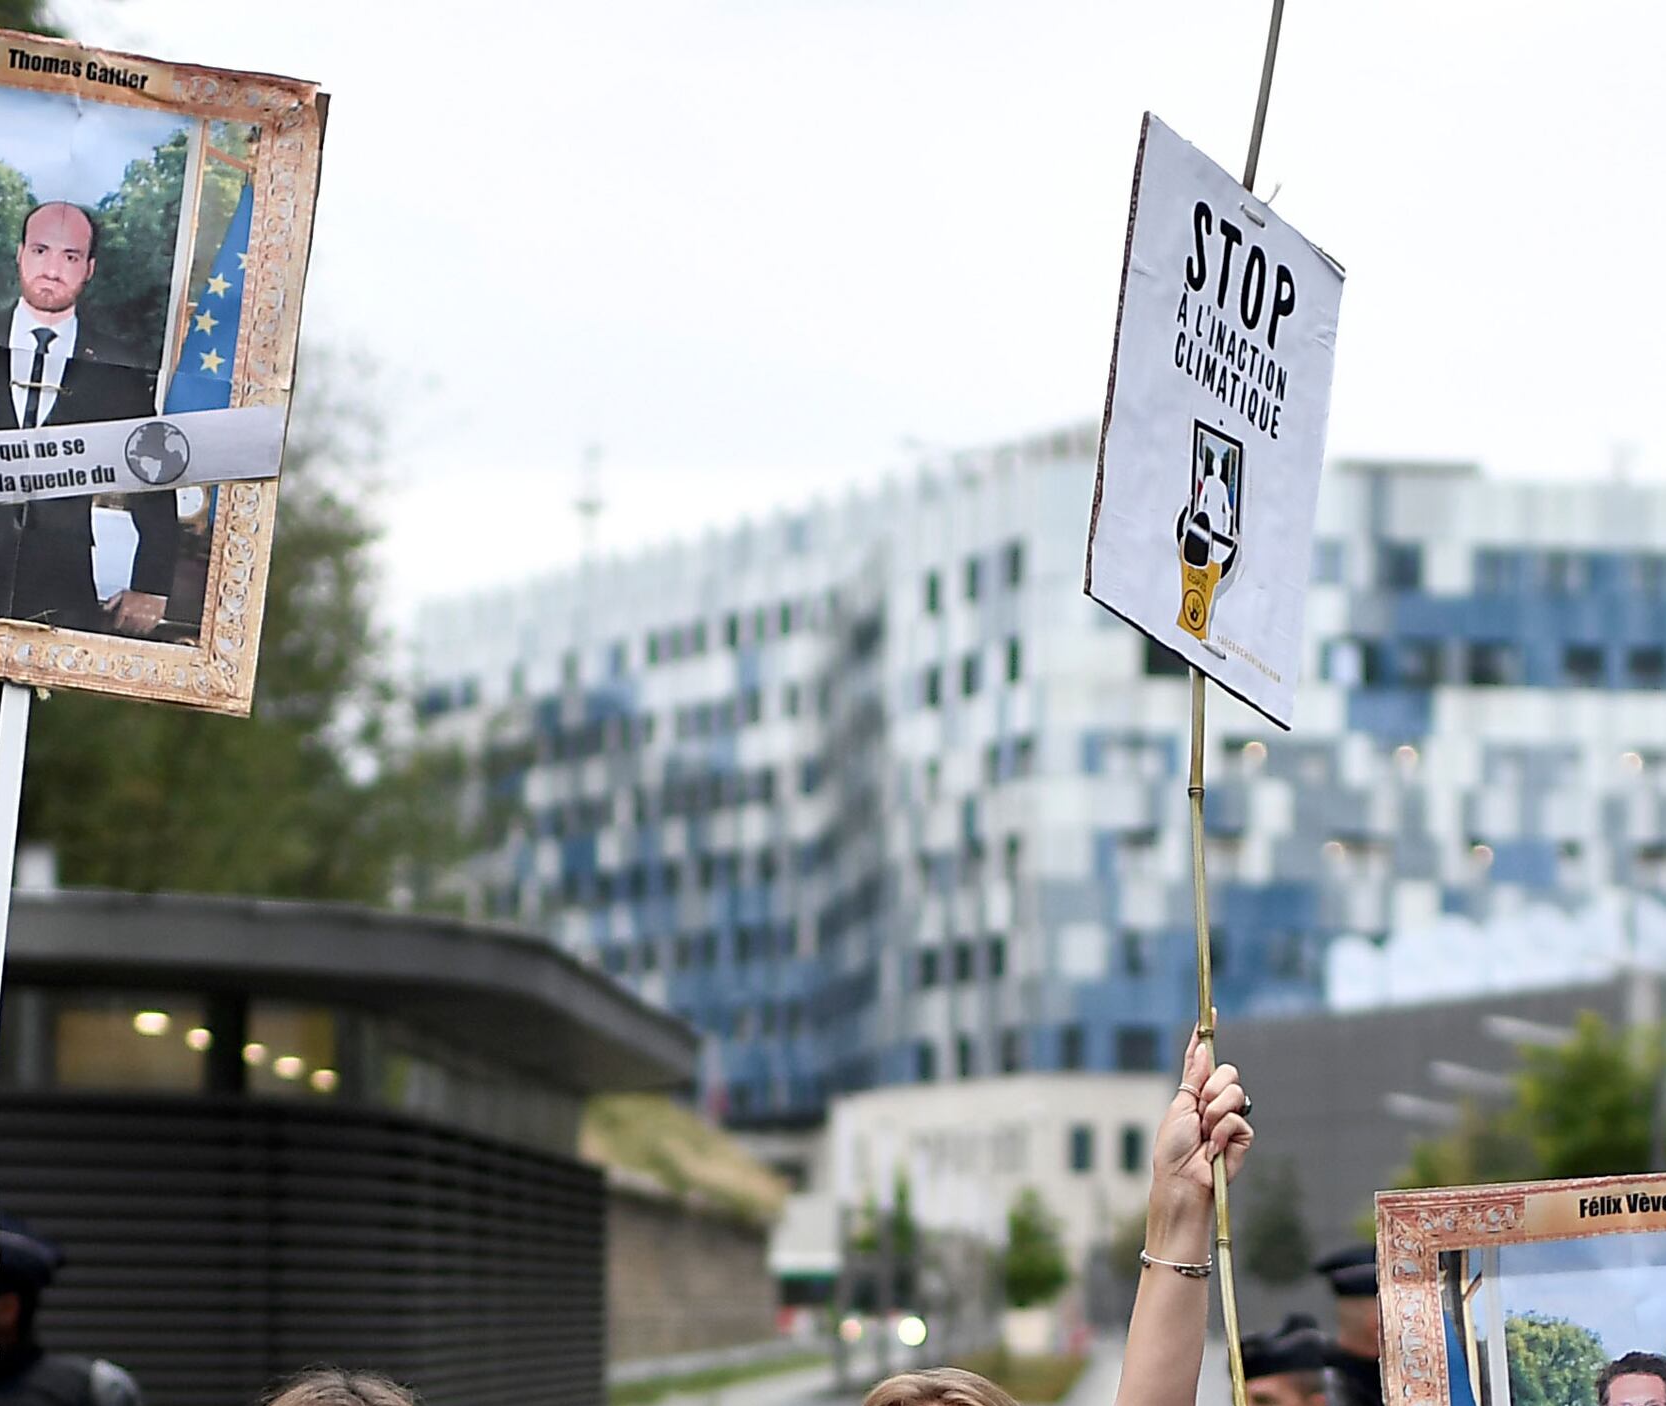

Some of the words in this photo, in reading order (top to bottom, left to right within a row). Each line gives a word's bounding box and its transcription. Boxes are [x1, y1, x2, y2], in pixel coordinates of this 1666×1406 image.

[8, 48, 82, 78] Thomas
[1186, 201, 1296, 350] STOP
[1177, 282, 1189, 328] À
[1196, 304, 1287, 401] L'INACTION
[1175, 331, 1282, 440] CLIMATIQUE
[0, 440, 30, 462] qui
[35, 442, 58, 458] ne
[63, 438, 85, 455] se
[20, 467, 88, 493] gueule
[91, 464, 116, 484] du
[1579, 1195, 1622, 1218] Félix
